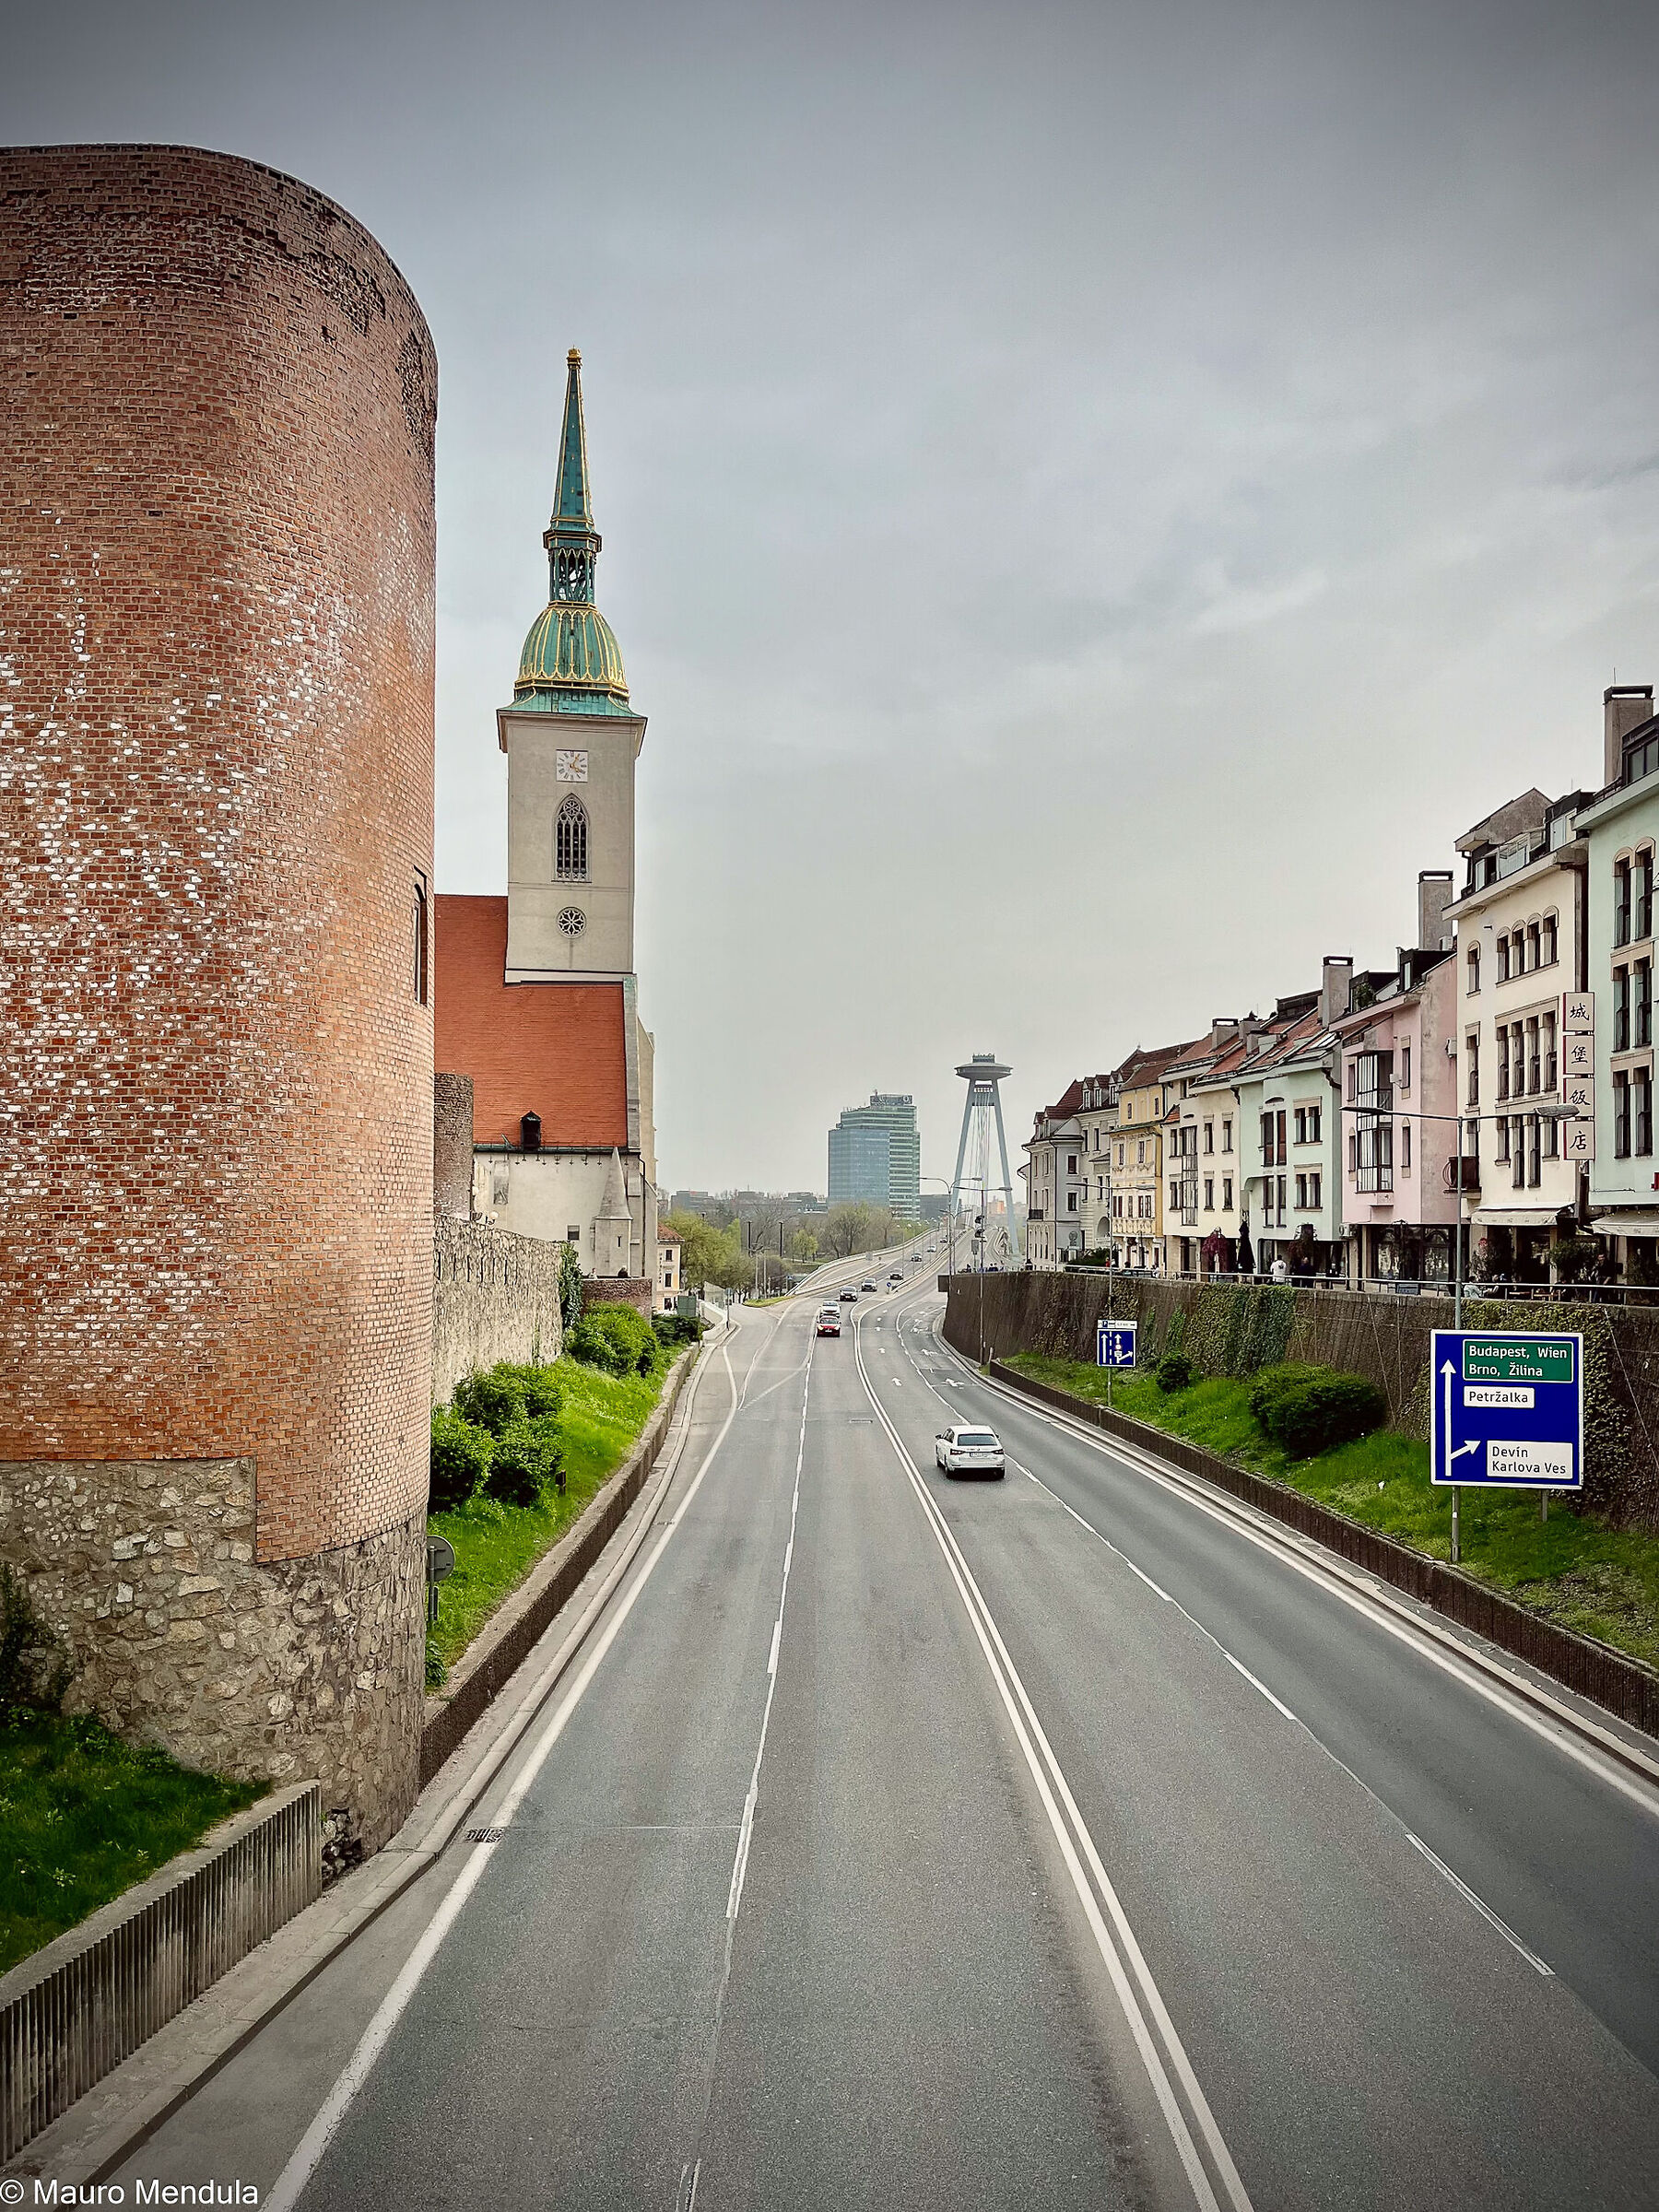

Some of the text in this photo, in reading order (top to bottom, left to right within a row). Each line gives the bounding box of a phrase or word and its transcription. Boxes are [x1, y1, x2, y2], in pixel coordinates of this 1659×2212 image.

[1468, 1345, 1568, 1359] Budapest, Wien
[1468, 1362, 1543, 1377] Brno, Žilina
[1469, 1391, 1528, 1403] Petržalka
[1492, 1446, 1528, 1458] Devín
[1492, 1461, 1566, 1475] Karlova Ves
